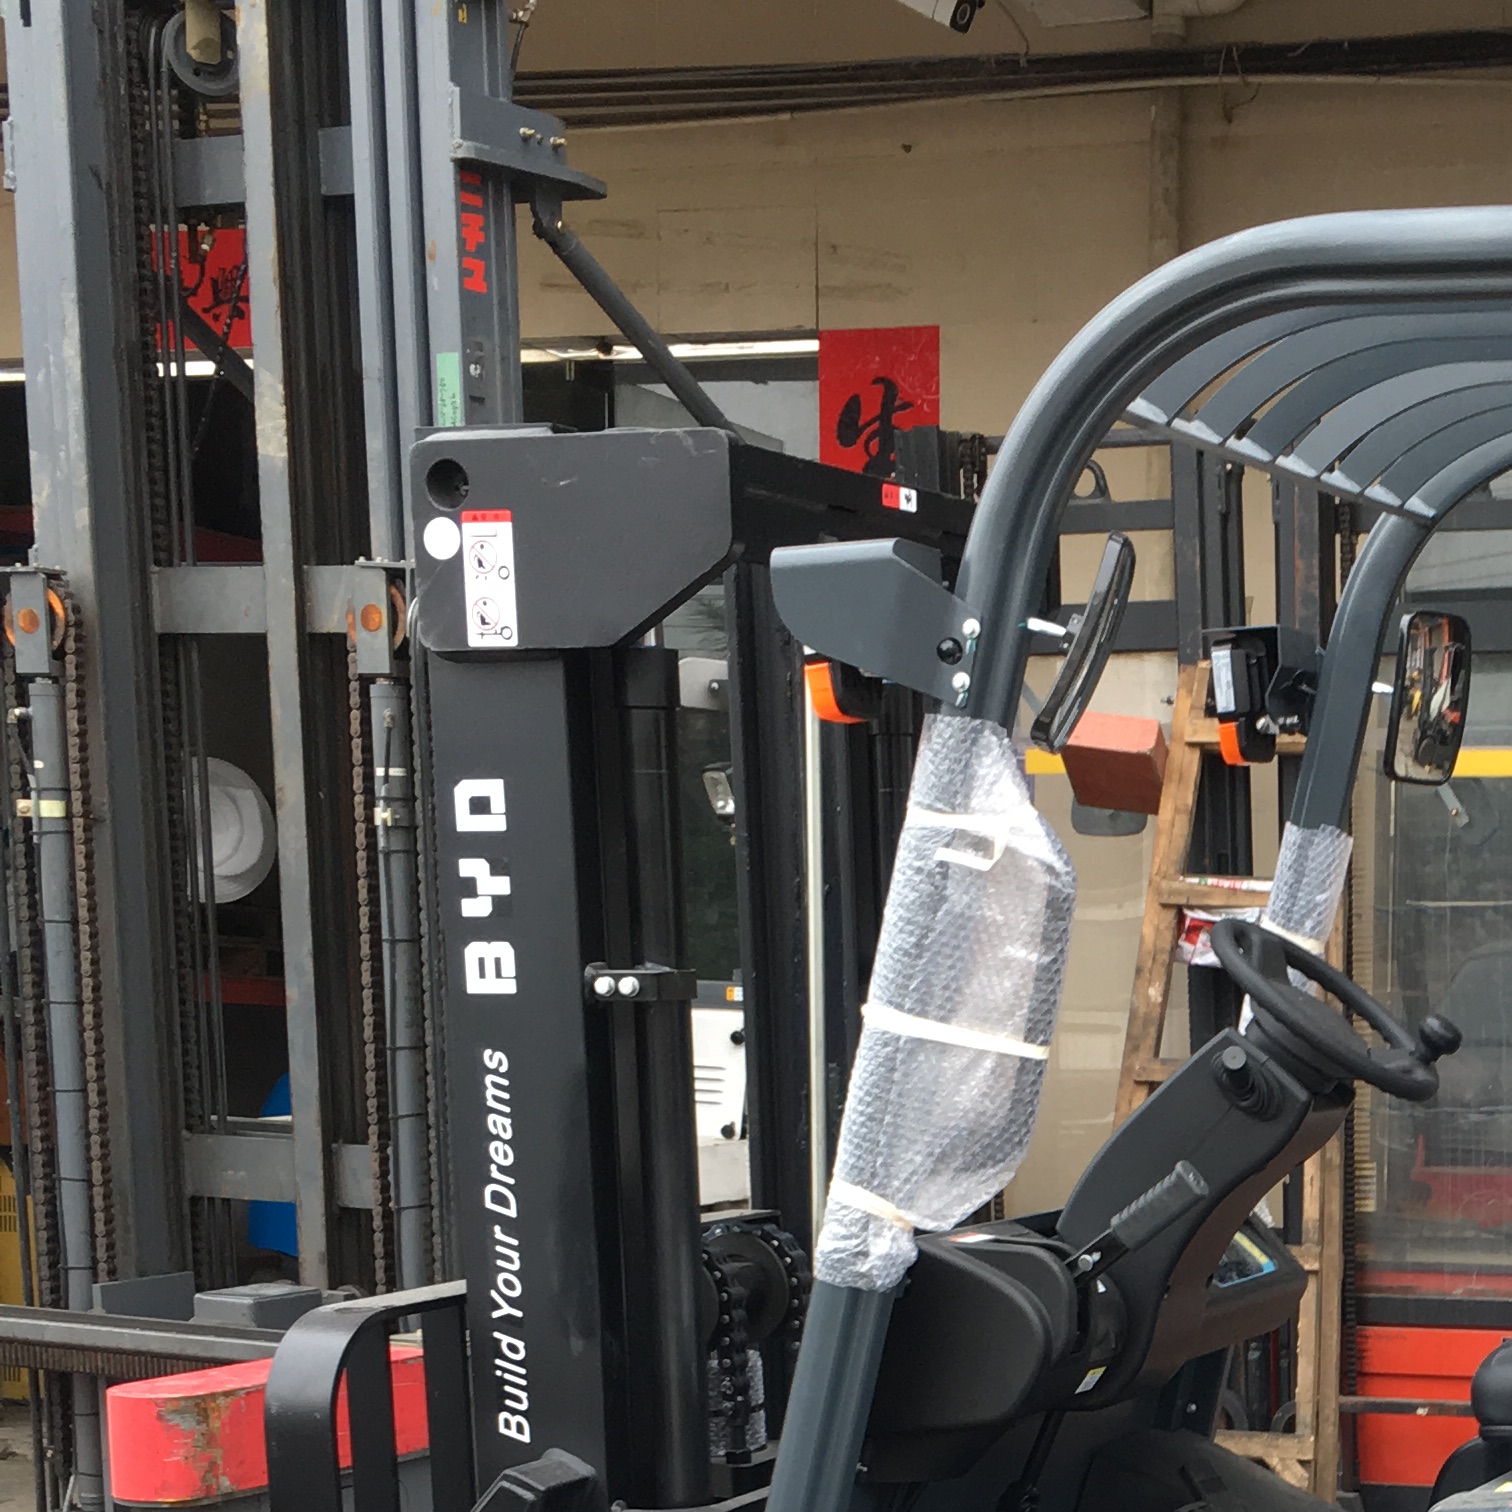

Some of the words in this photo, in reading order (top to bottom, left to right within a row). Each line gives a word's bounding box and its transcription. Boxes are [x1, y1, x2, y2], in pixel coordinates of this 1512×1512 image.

[454, 778, 517, 994] BYD
[483, 1048, 518, 1219] Dreams
[490, 1224, 524, 1319] Your
[492, 1330, 531, 1444] Build
